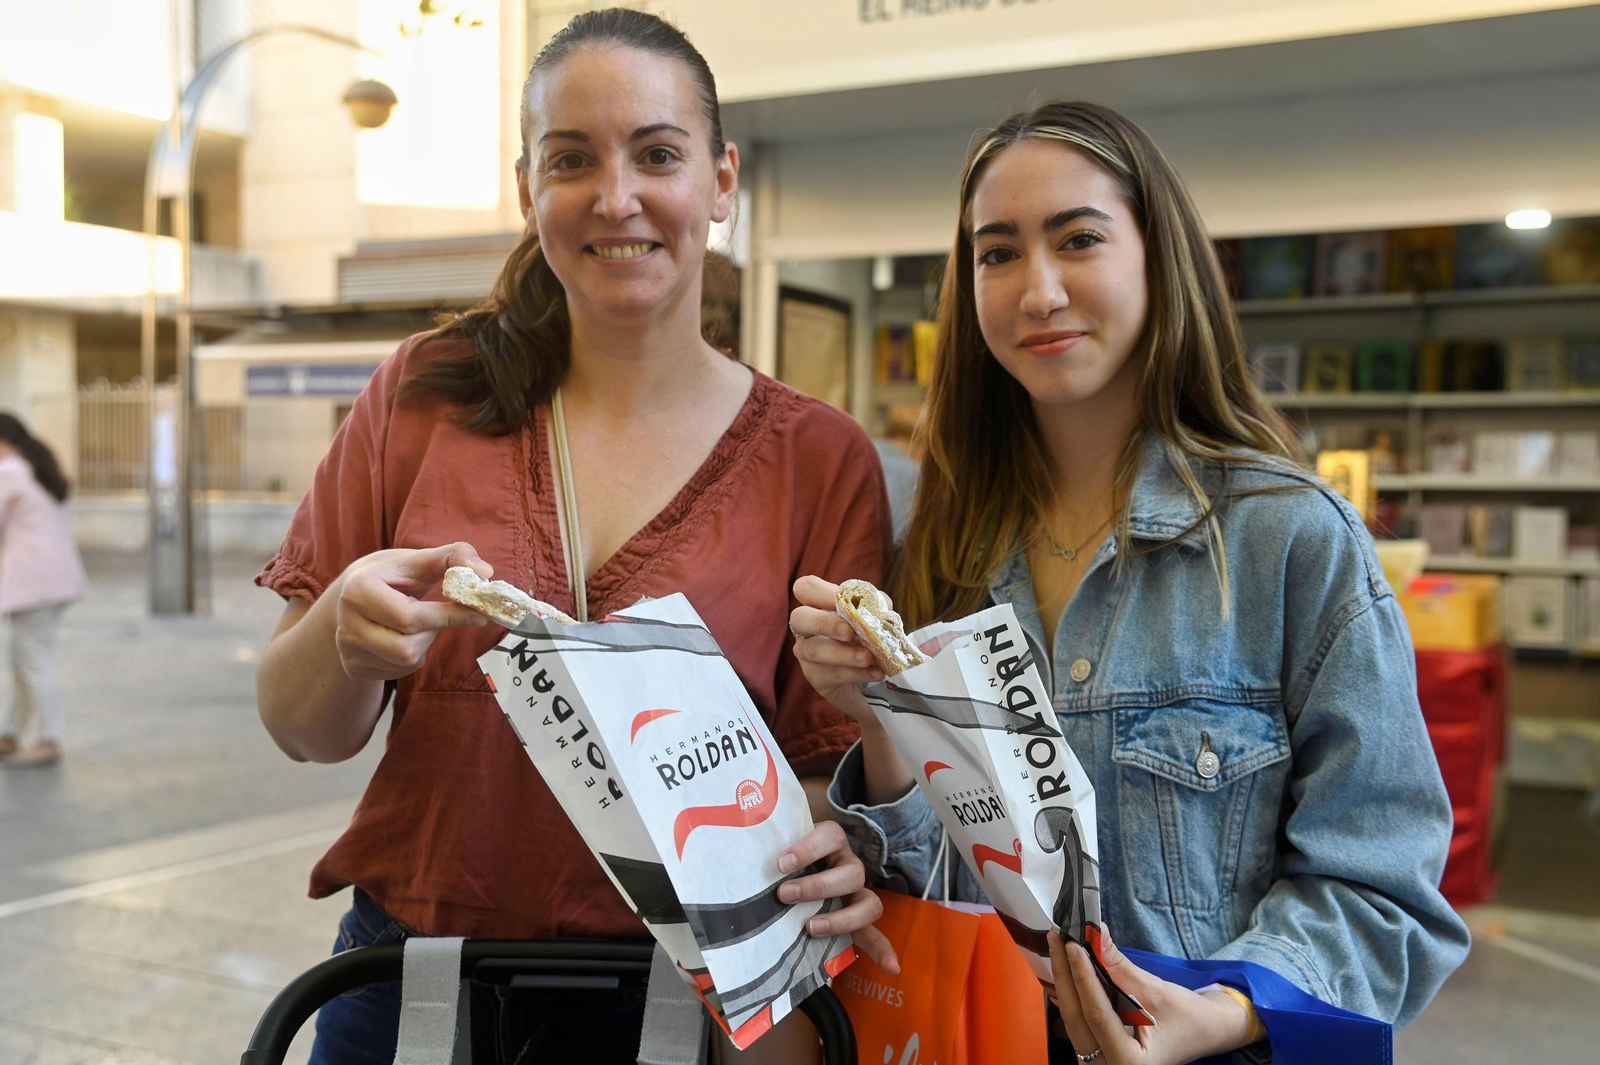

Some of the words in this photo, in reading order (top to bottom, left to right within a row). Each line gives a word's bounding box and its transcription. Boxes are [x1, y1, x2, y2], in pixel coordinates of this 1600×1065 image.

[506, 655, 611, 809] HERMANO
[649, 717, 745, 763] HERMANOS
[983, 622, 1072, 802] ROLDAN
[655, 726, 758, 791] ROLDAN
[944, 785, 995, 803] HERMANO
